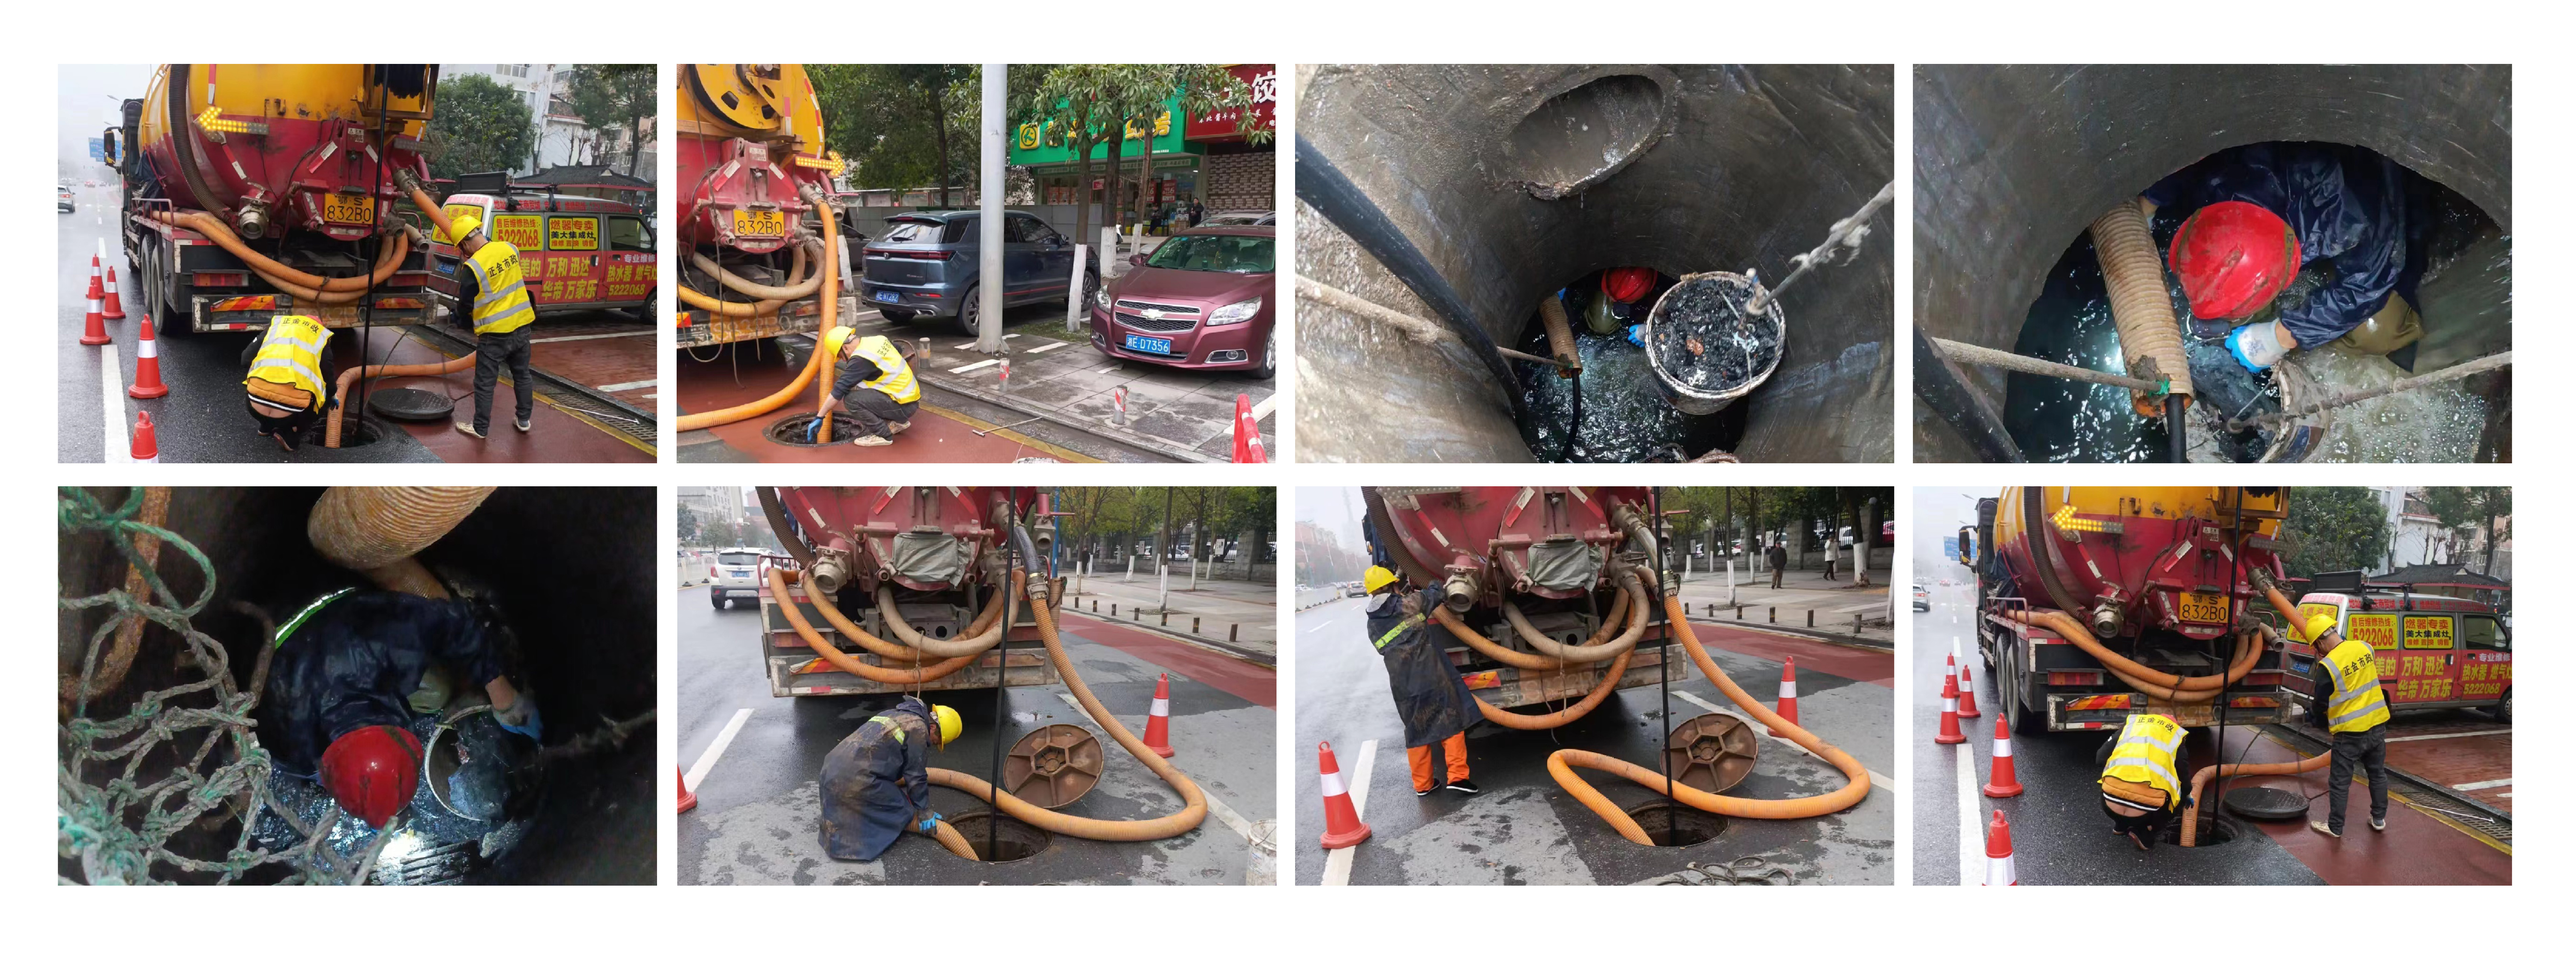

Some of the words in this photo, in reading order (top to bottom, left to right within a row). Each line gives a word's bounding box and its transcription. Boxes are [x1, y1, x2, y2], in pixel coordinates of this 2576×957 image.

[327, 205, 371, 223] 832B0
[551, 231, 594, 239] 美大集成灶
[737, 220, 782, 235] 832B0
[498, 229, 539, 247] 5222068
[488, 254, 518, 278] 正金市政
[521, 258, 541, 277] 美的
[546, 257, 568, 277] 万和
[570, 257, 590, 277] 迅达
[624, 254, 655, 263] 专业维修
[607, 265, 633, 282] 热水器
[542, 281, 563, 301] 华帝
[565, 279, 598, 299] 万家乐
[609, 284, 646, 295] 5222068
[282, 318, 320, 334] 正金市政
[2182, 604, 2226, 622] 832B0
[2353, 628, 2394, 646] 5222068
[2406, 630, 2449, 638] 美大集成灶
[2343, 653, 2373, 677] 正金市政
[2376, 657, 2396, 676] 美的
[2402, 656, 2423, 676] 万和
[2425, 656, 2445, 676] 迅达
[2479, 653, 2510, 662] 专业维修
[2462, 664, 2488, 681] 热水器
[2397, 680, 2418, 700] 华帝
[2420, 678, 2453, 698] 万家乐
[2464, 683, 2501, 694] 5222068
[2137, 717, 2175, 733] 正金市政
